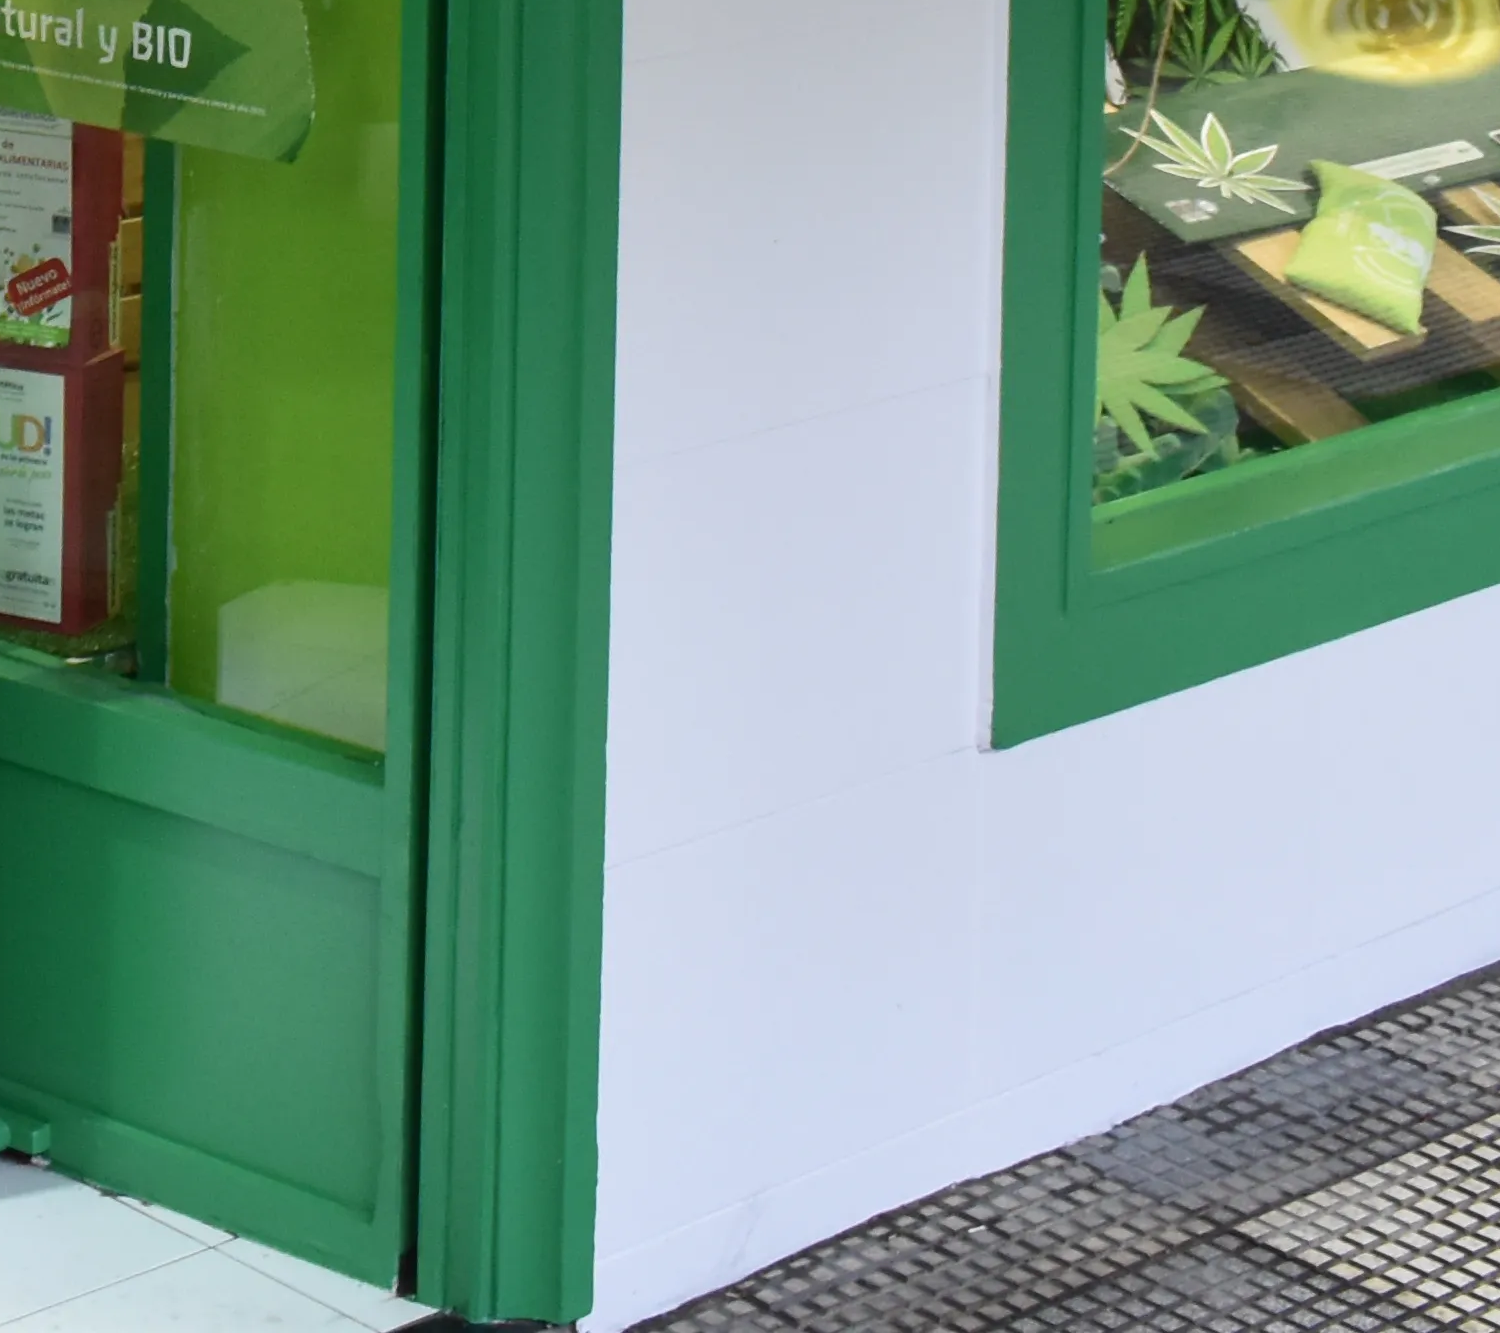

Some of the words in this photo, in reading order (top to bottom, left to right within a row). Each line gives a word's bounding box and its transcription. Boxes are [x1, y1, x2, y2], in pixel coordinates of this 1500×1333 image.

[98, 24, 118, 65] y
[131, 20, 192, 70] BIO
[15, 268, 58, 296] Nuevo
